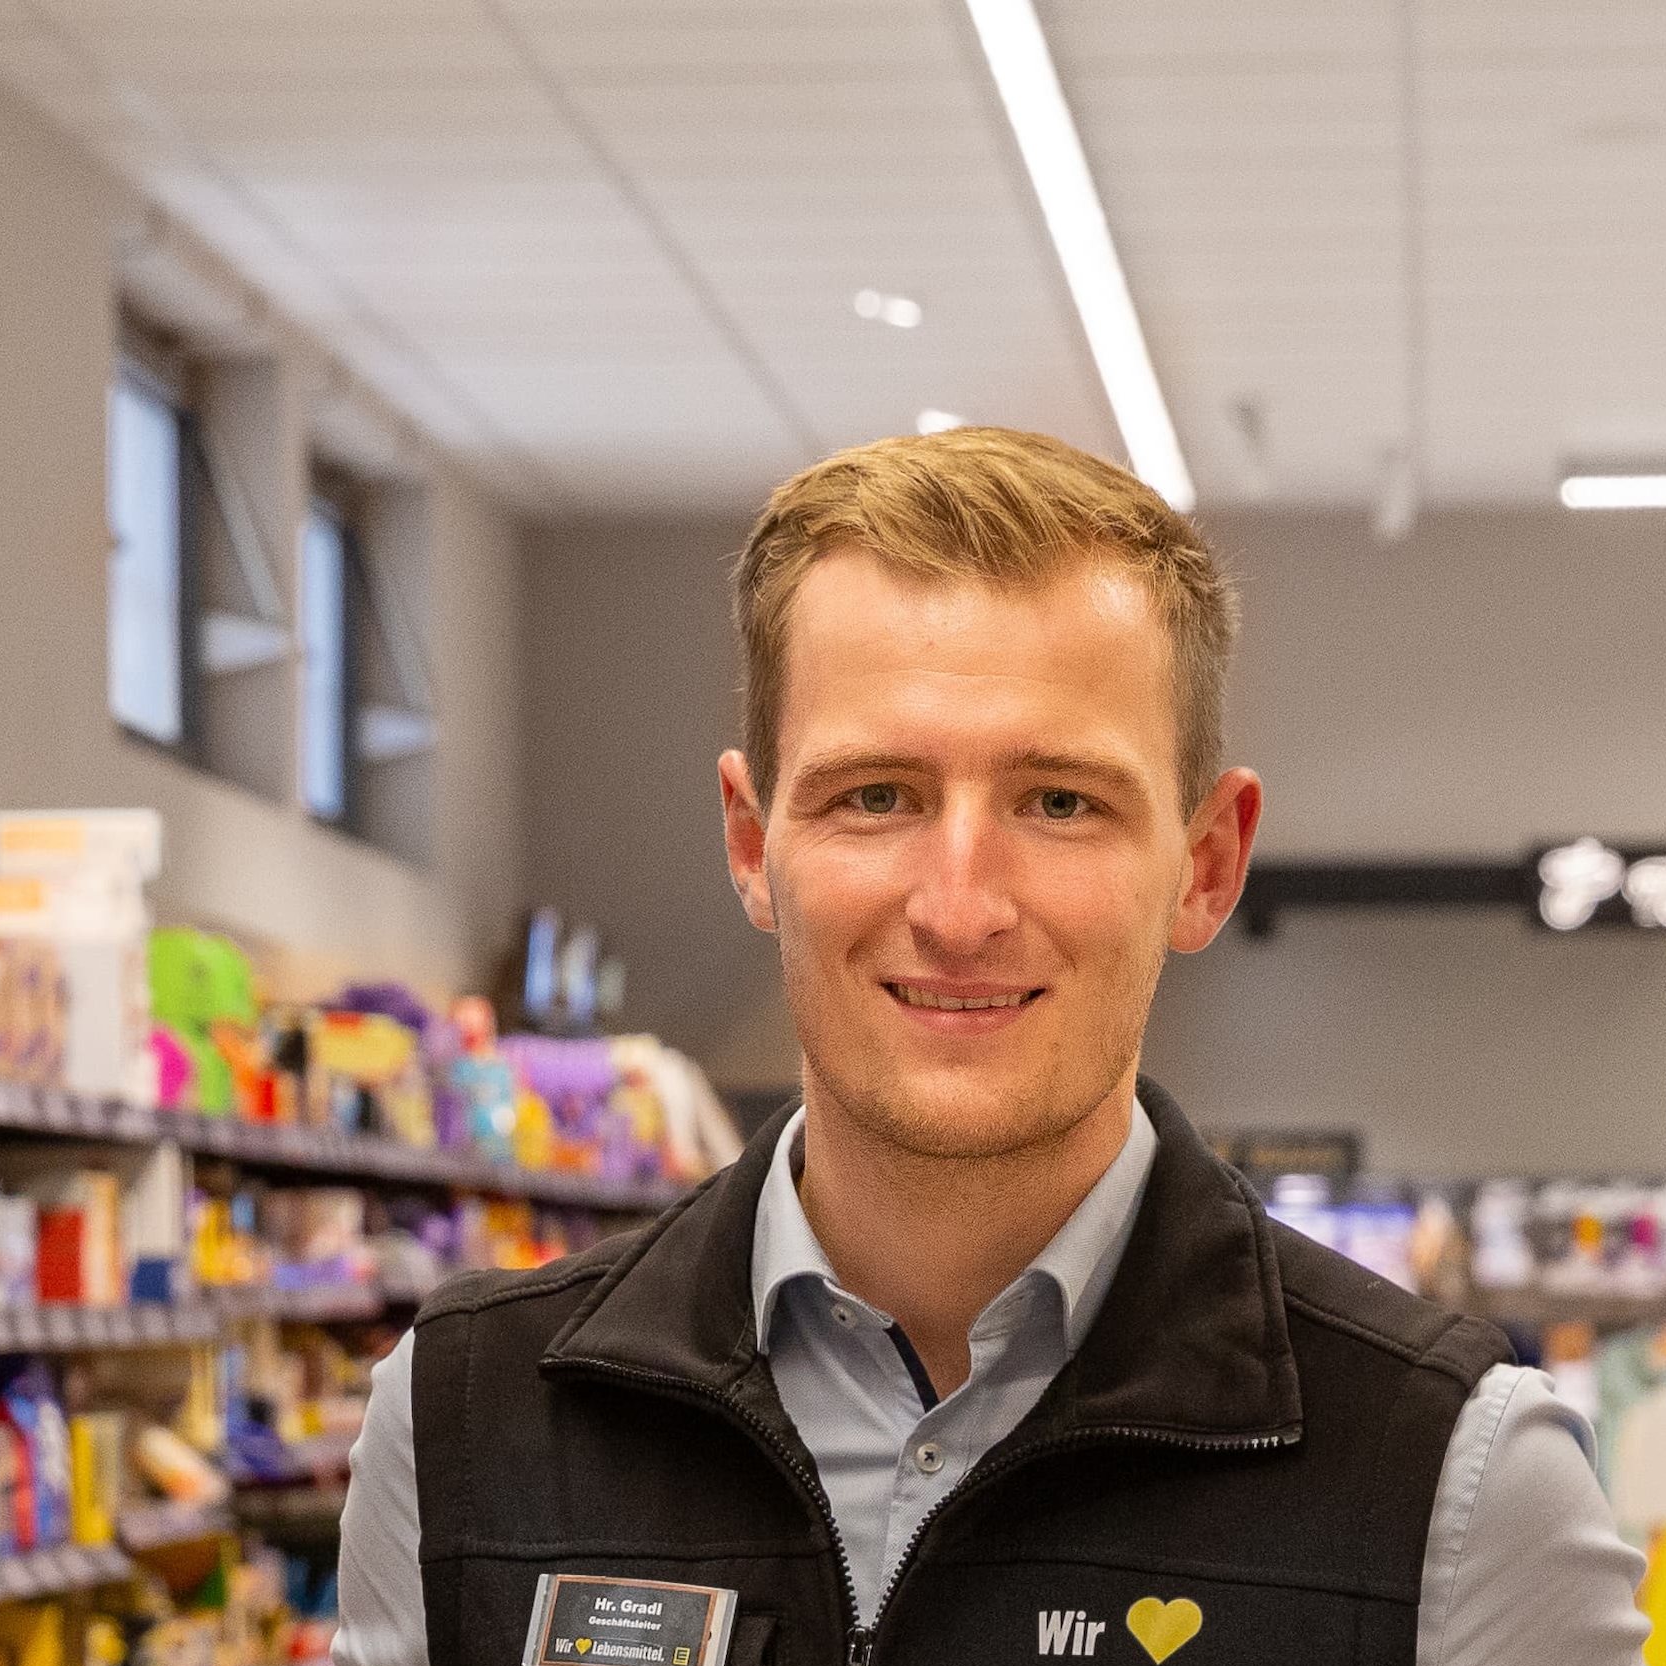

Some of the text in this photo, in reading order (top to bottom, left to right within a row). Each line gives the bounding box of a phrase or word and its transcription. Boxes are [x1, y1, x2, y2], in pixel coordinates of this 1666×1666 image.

[594, 1597, 663, 1616] Hr. Gradl
[588, 1615, 662, 1631] Geschäftsleiter
[1038, 1610, 1106, 1656] Wir
[555, 1637, 665, 1662] Wir Lebensmittel.
